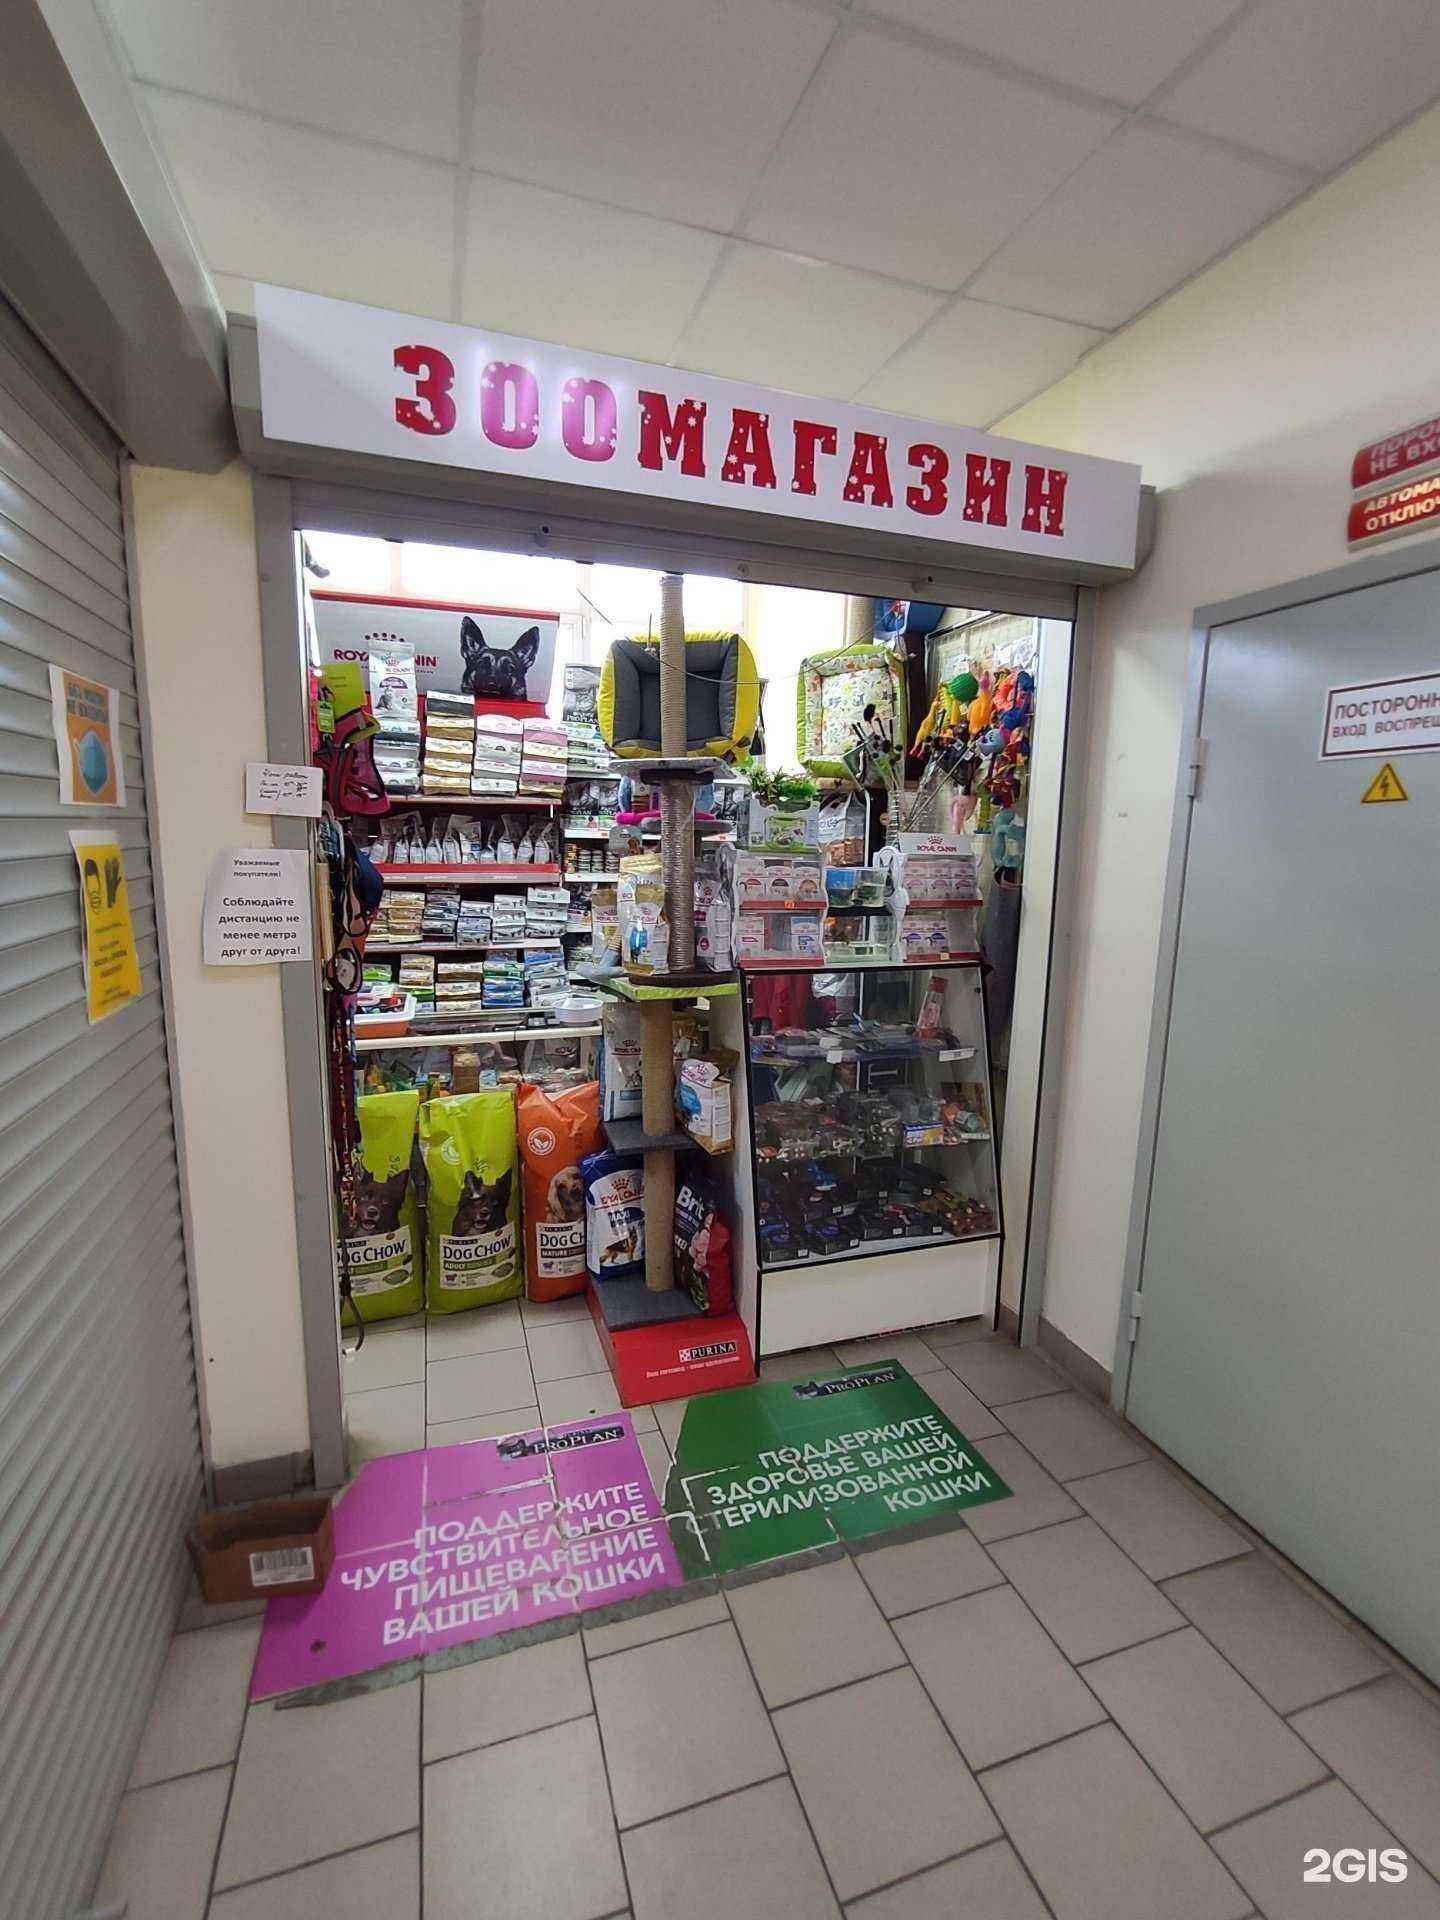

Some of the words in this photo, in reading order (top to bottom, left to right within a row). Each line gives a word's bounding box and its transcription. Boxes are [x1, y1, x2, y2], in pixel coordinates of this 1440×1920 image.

[394, 344, 1069, 537] ЗООМАГАЗИН
[1370, 452, 1399, 475] НЕ
[333, 649, 369, 661] ROYA
[1333, 724, 1367, 738] ВХОД
[222, 897, 295, 907] Соблюдайте
[218, 915, 283, 925] дистанцию
[286, 915, 300, 923] не
[263, 932, 297, 940] метра
[221, 948, 247, 957] друг
[264, 946, 301, 957] друга!
[676, 1185, 705, 1220] Brit
[363, 1240, 406, 1261] CHOW
[691, 1342, 736, 1359] PURINA
[758, 1414, 943, 1469] ПОДДЕРЖИТЕ
[706, 1455, 860, 1505] ЗДОРОВЬЕ
[862, 1430, 957, 1468] ВАШЕЙ
[883, 1470, 991, 1512] КОШКИ
[413, 1482, 643, 1549] ПОДДЕРЖИТЕ
[341, 1503, 650, 1591] ЧУВСТВИТЕЛЬНОЕ
[394, 1527, 658, 1610] ПИЩЕВАРЕНИЕ
[382, 1584, 520, 1646] ВАШЕЙ
[532, 1552, 665, 1607] КОШКИ
